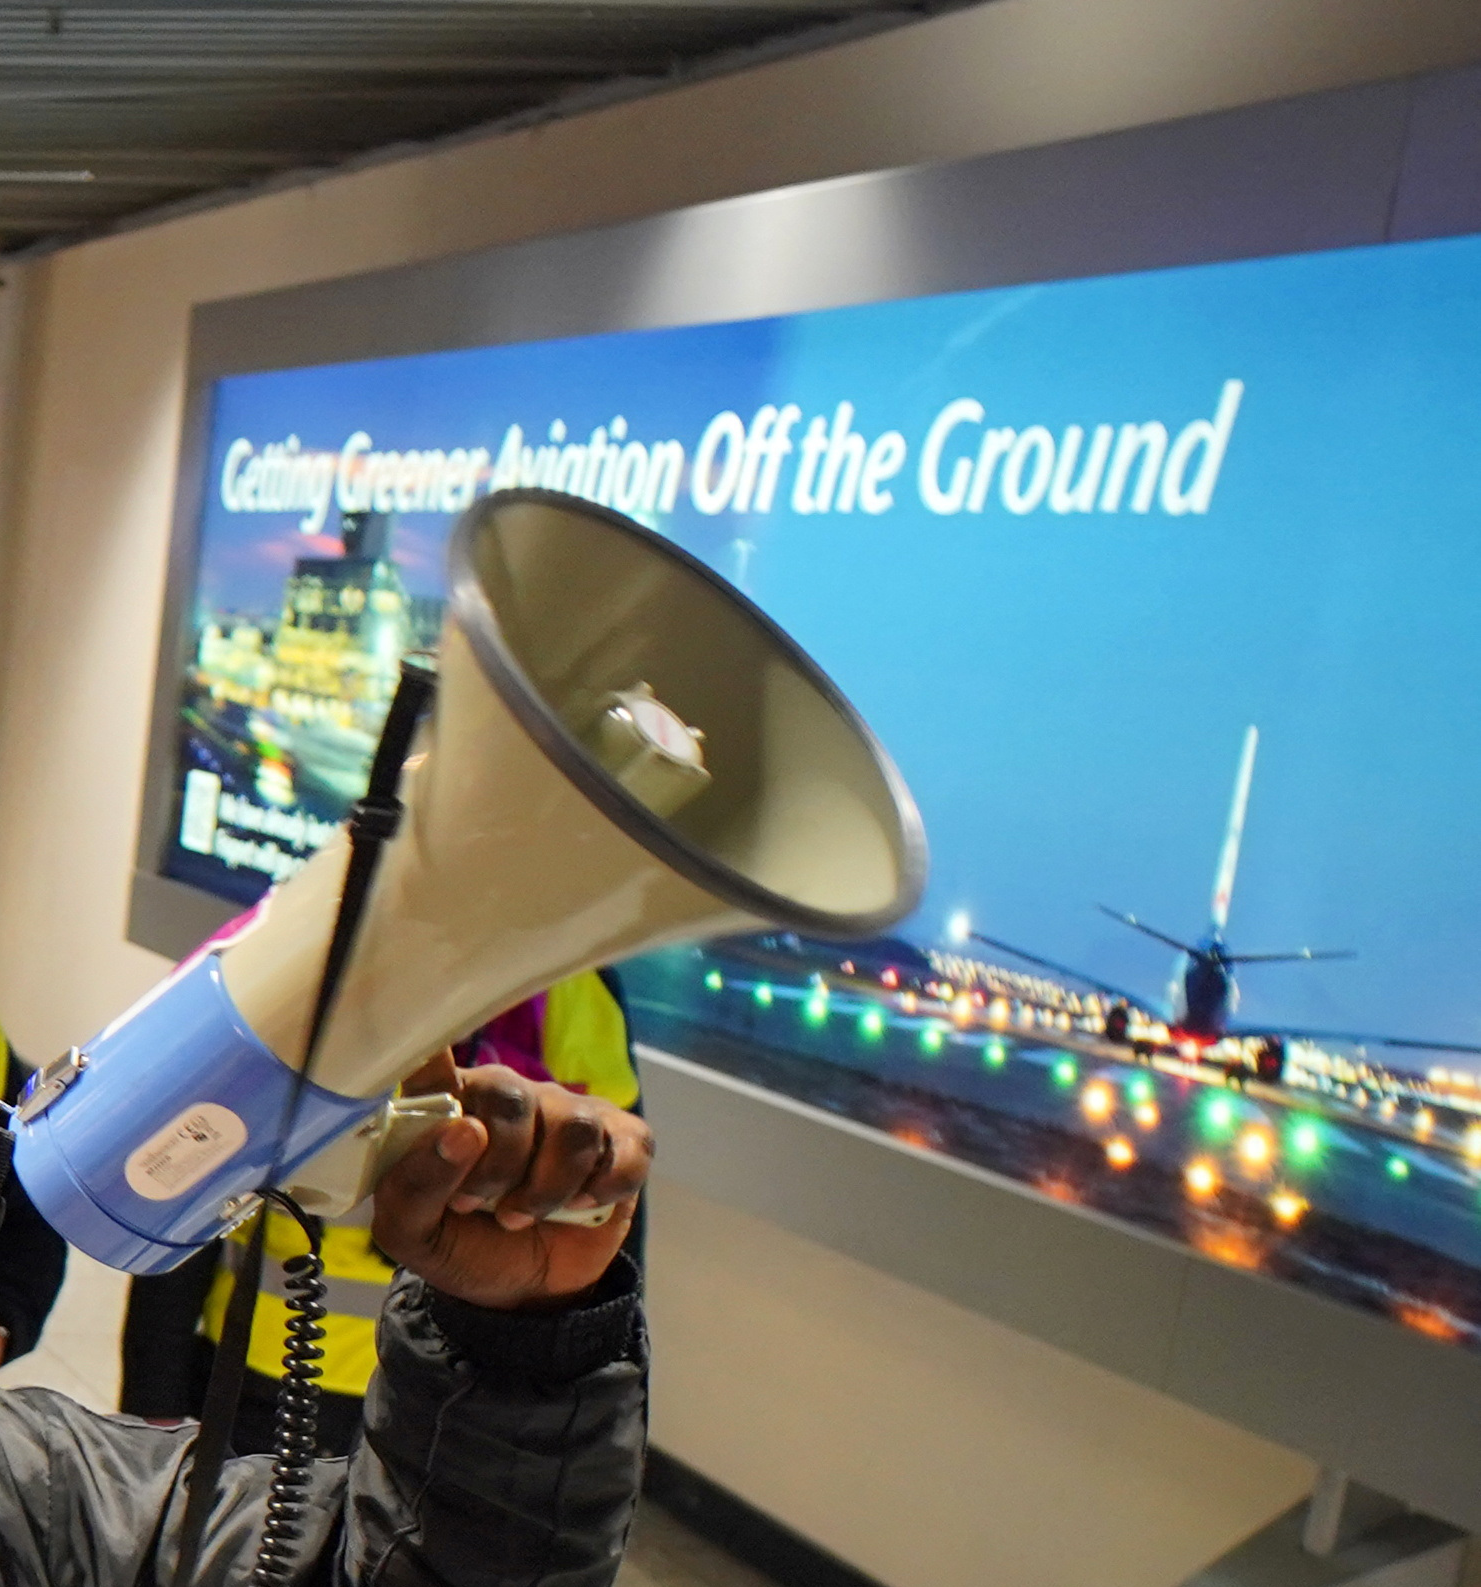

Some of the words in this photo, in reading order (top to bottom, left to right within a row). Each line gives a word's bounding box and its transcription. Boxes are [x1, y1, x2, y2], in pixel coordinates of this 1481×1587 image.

[221, 433, 335, 535] Getting
[337, 430, 491, 514] Greener
[490, 414, 685, 515] Aviation
[691, 403, 802, 516] Off
[790, 400, 907, 516] the
[917, 377, 1245, 516] Ground
